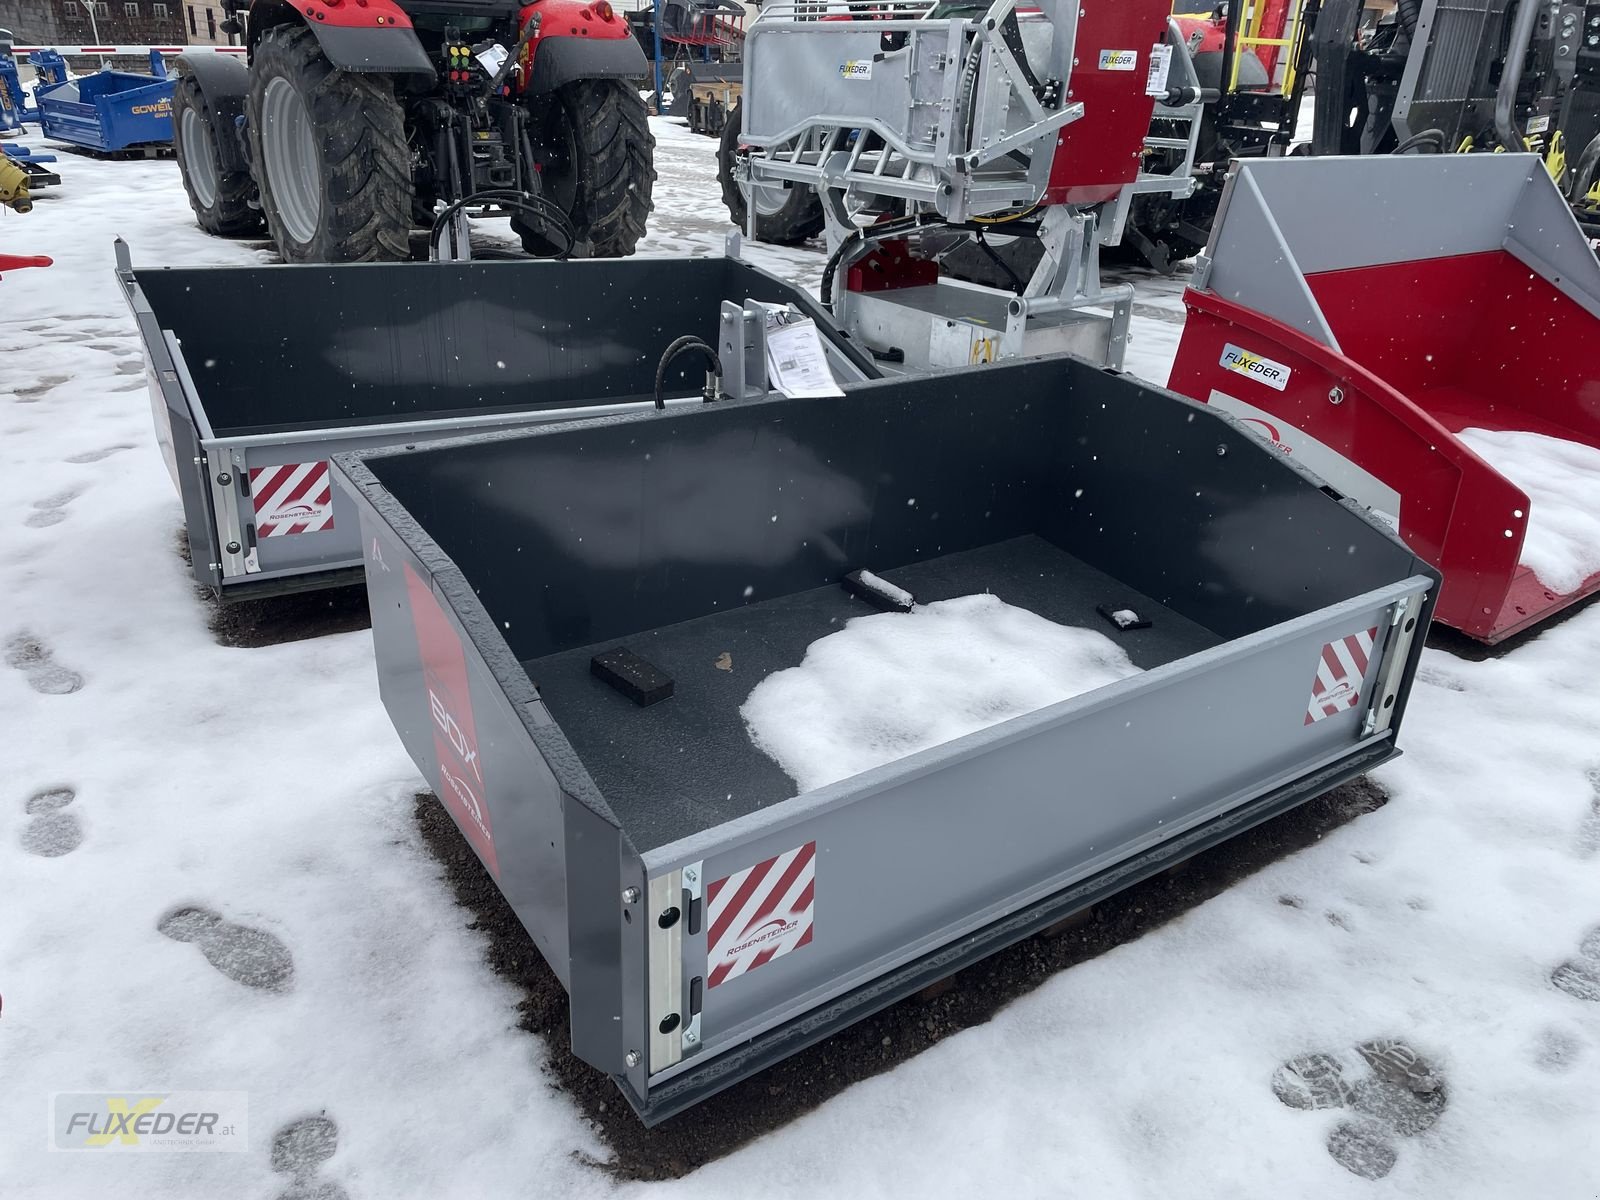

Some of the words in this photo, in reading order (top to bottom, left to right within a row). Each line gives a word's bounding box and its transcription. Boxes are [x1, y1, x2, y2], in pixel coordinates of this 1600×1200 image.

[269, 510, 322, 520] ROSENSTEINER
[429, 687, 481, 783] BOX
[441, 763, 491, 840] ROSENSTEINER
[726, 919, 799, 957] ROSENSTEINER
